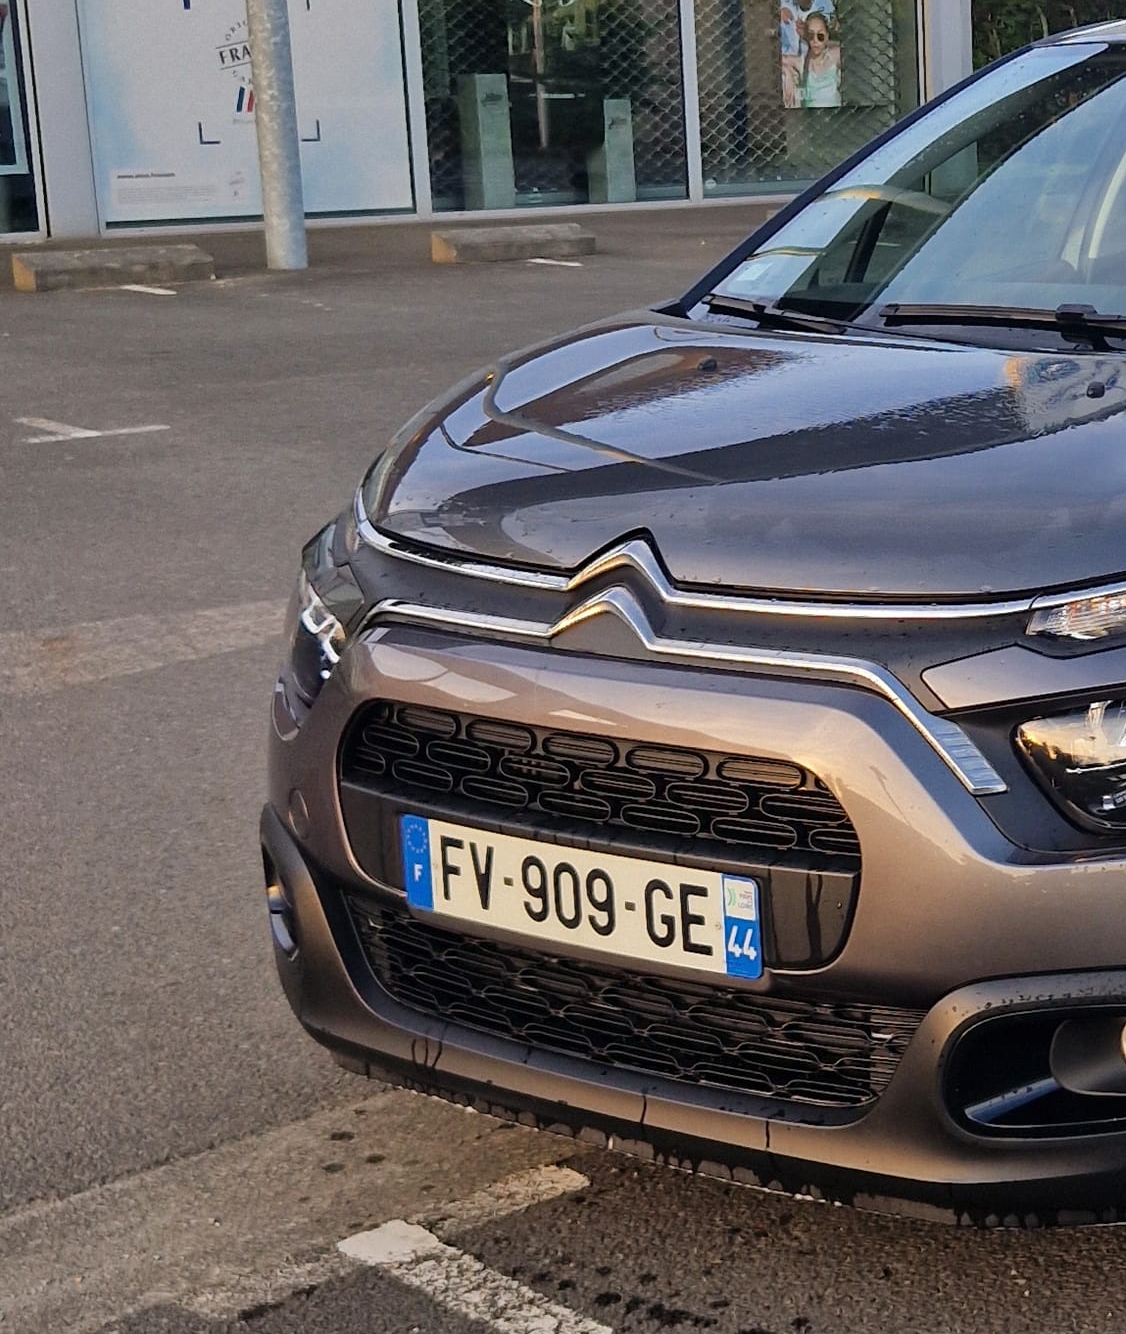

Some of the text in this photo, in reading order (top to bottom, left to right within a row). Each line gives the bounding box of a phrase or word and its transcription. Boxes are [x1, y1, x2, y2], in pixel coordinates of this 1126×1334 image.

[414, 862, 424, 883] F
[440, 835, 714, 956] FV-909-GE
[727, 925, 757, 961] 44
